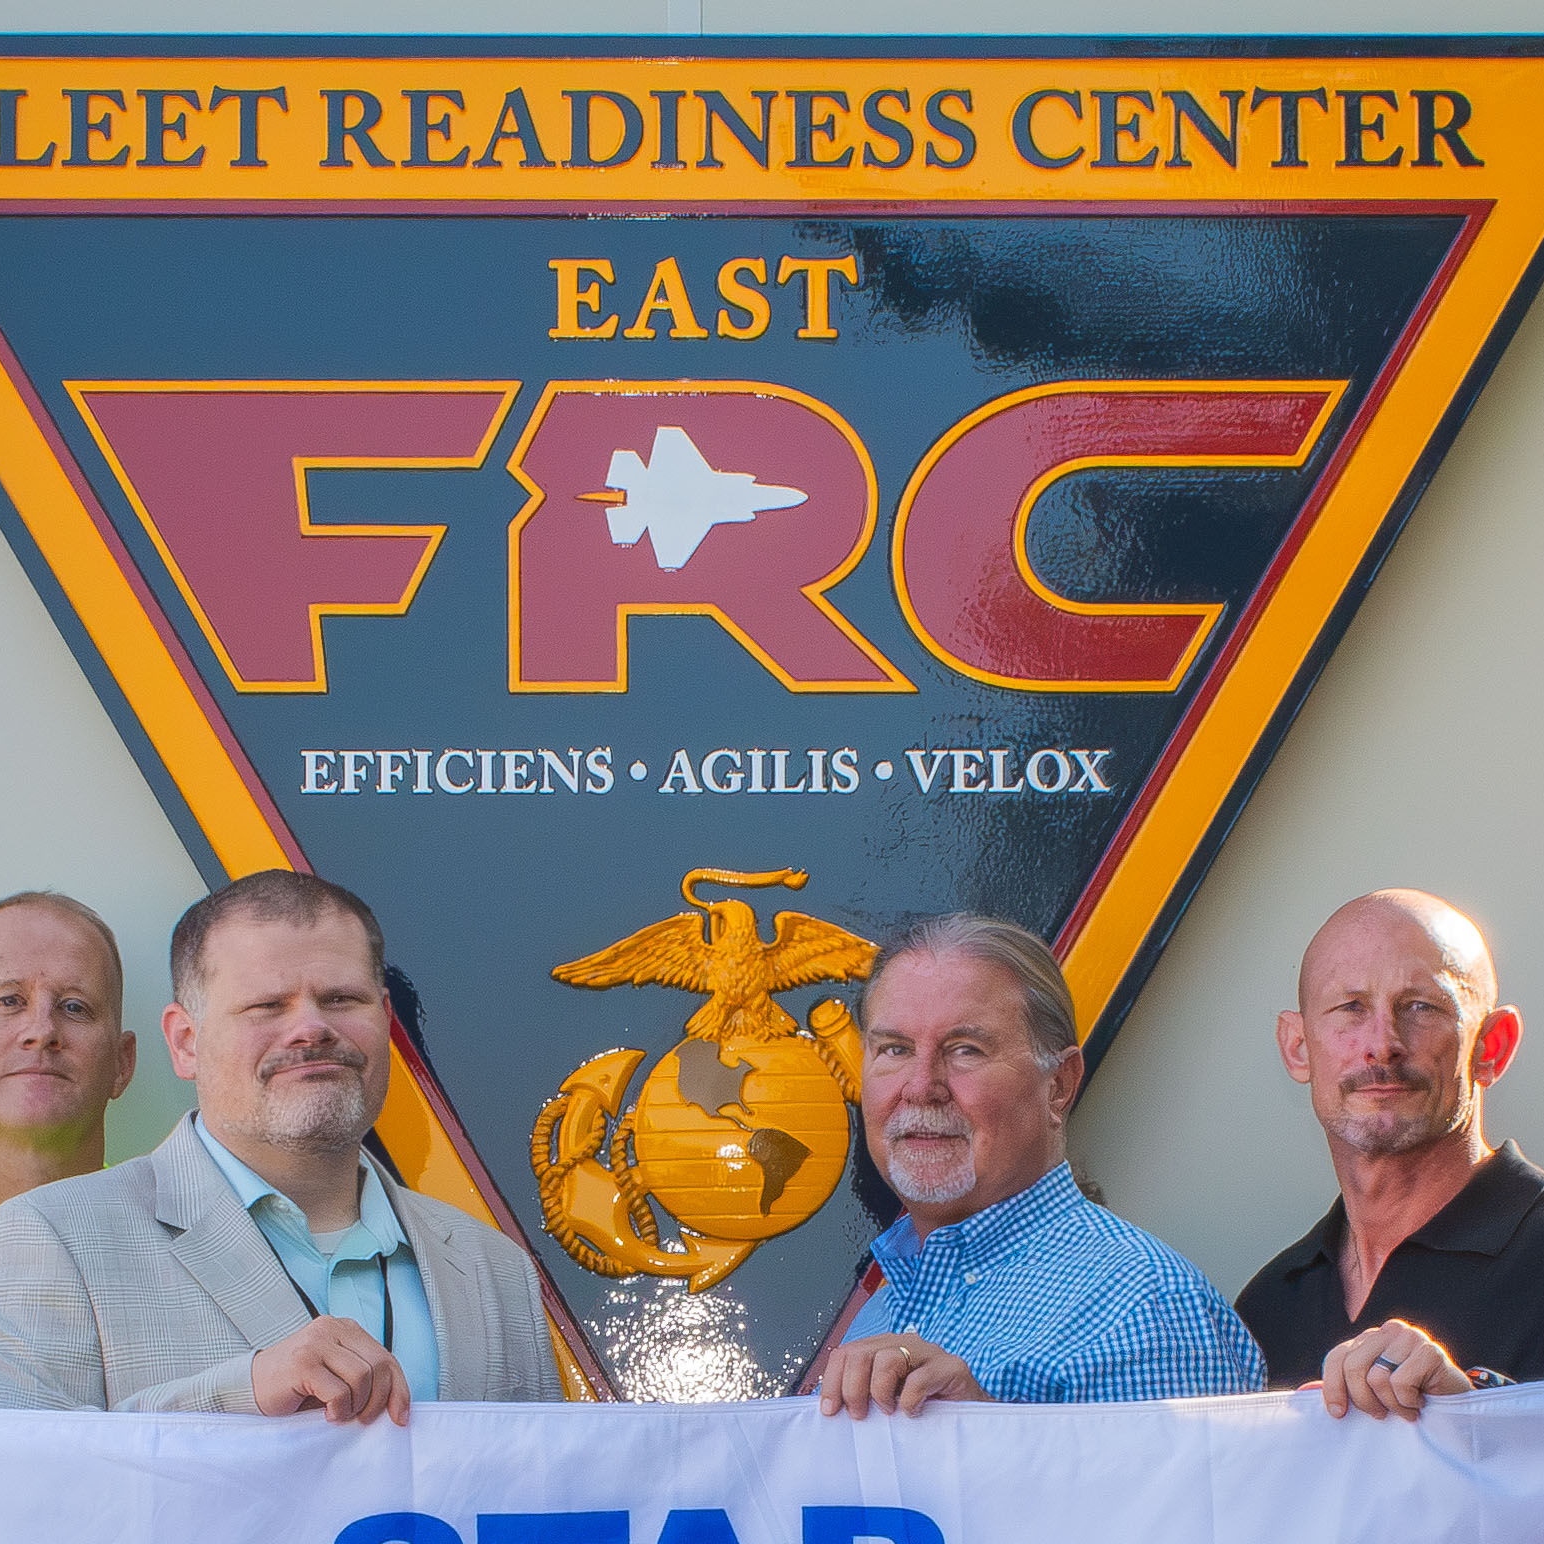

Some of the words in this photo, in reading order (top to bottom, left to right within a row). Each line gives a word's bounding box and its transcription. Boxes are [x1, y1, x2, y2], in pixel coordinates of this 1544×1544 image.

[319, 88, 977, 168] READINESS
[1012, 86, 1485, 168] CENTER
[547, 254, 859, 341] EAST
[60, 378, 1351, 695] FRC
[299, 746, 613, 795] EFFICIENS
[658, 747, 859, 795] AGILIS
[905, 746, 1113, 795] VELOX
